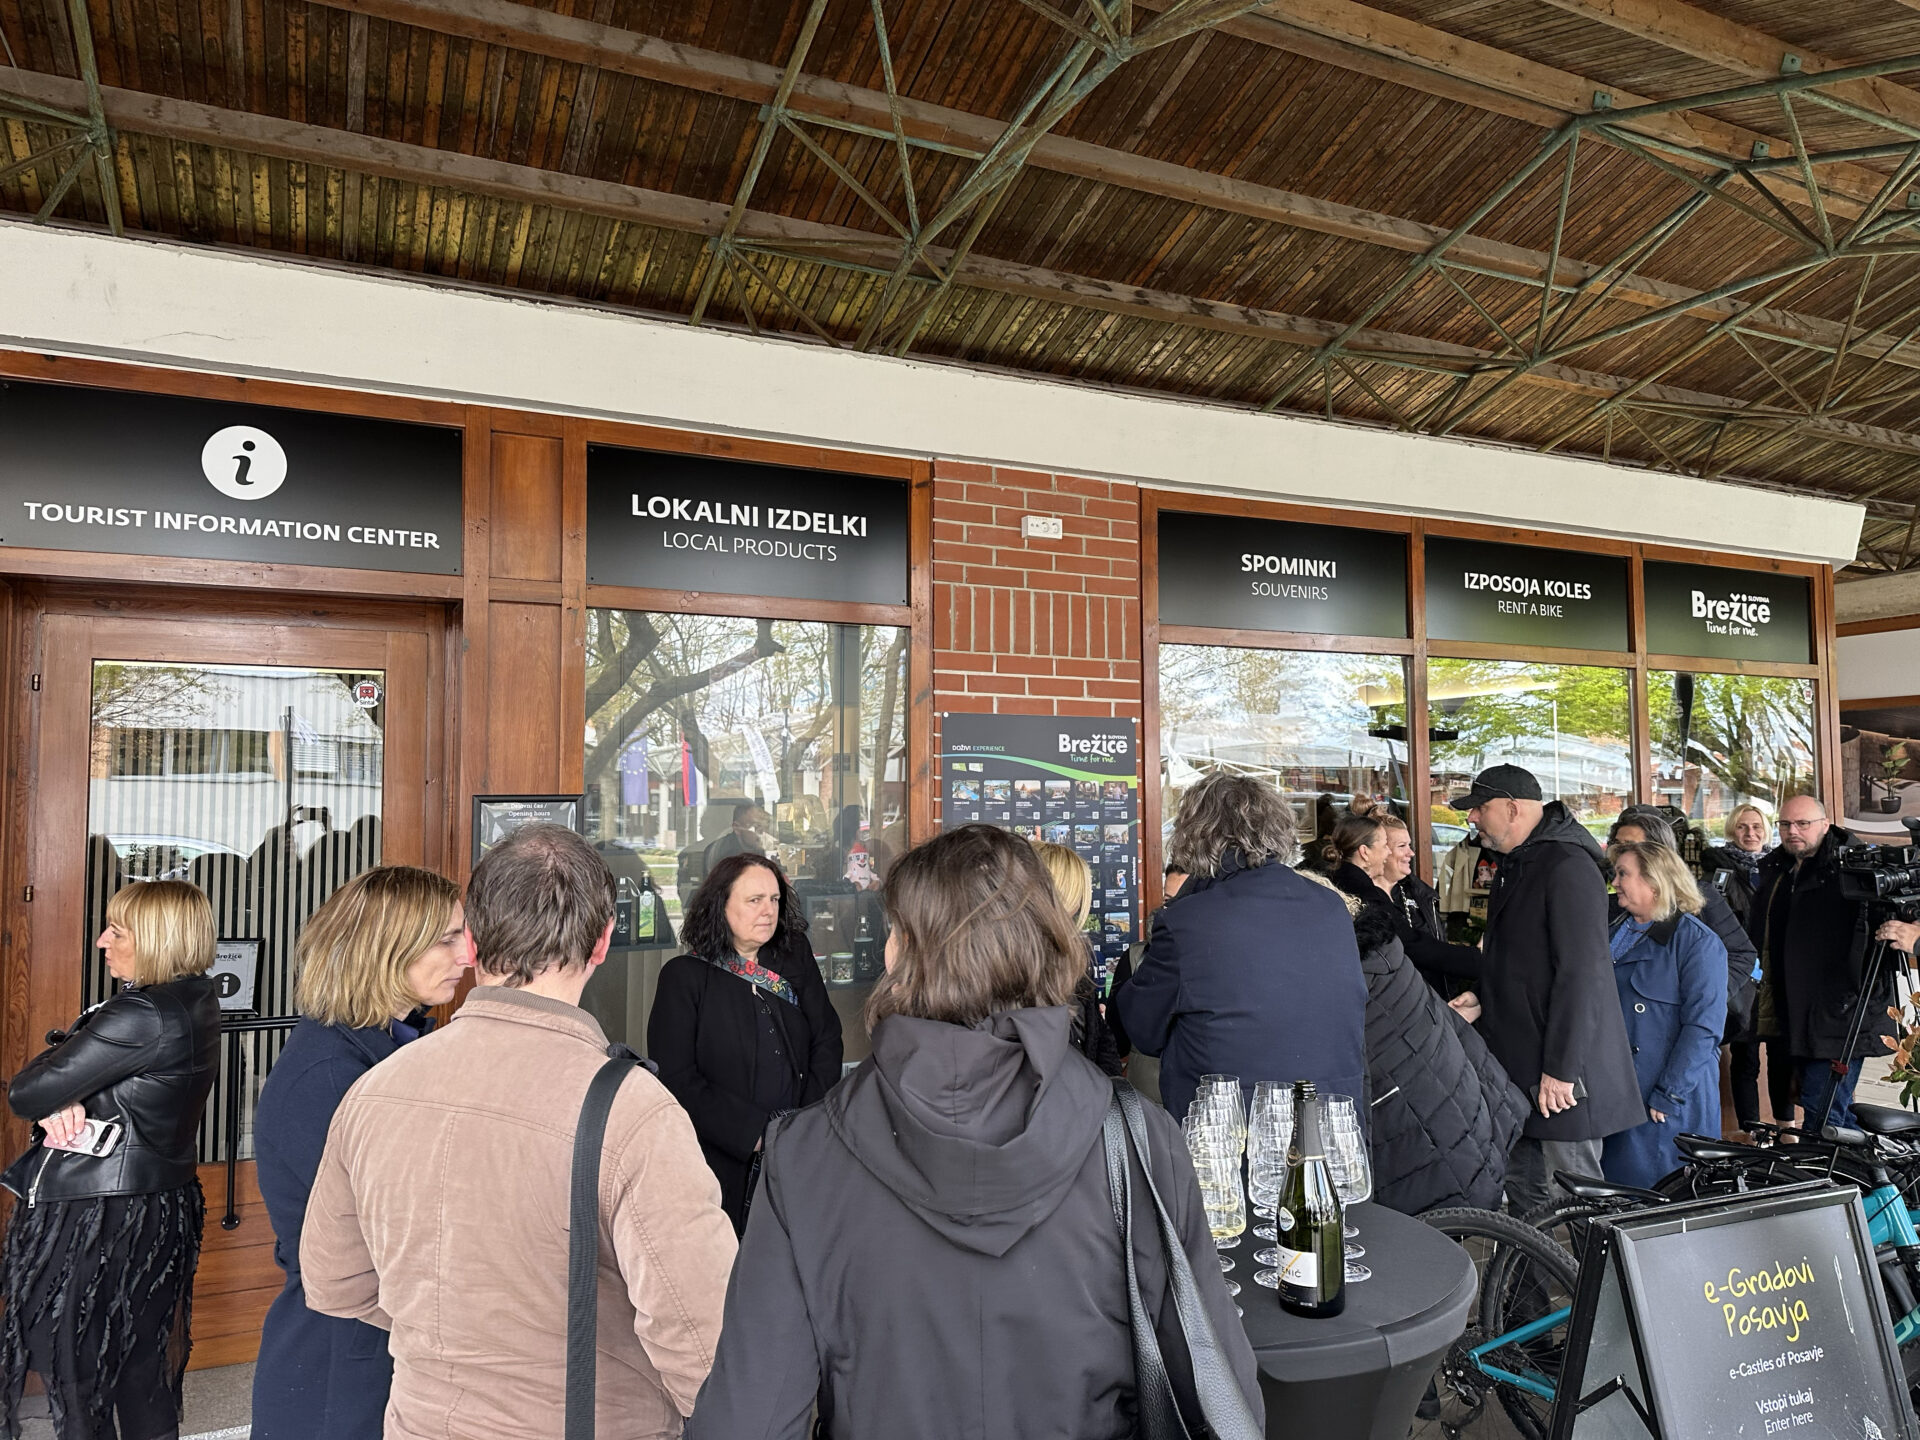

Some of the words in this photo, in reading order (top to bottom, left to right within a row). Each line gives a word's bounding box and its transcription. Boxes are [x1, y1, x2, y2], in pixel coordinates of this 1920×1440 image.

[23, 501, 148, 528] TOURIST
[154, 511, 341, 542] INFORMATION
[347, 526, 441, 549] CENTER
[632, 493, 759, 528] LOKALNI
[767, 507, 867, 537] IZDELKI
[663, 531, 729, 553] LOCAL
[733, 537, 837, 562] PRODUCTS
[1241, 553, 1337, 579] SPOMINKI
[1251, 581, 1329, 601] SOUVENIRS
[1464, 571, 1541, 598] IZPOSOJA
[1544, 580, 1592, 600] KOLES
[1497, 600, 1529, 615] RENT
[1529, 602, 1539, 616] A
[1539, 603, 1564, 618] BIKE
[1691, 590, 1771, 626] Brežice
[1705, 620, 1728, 634] Time
[1728, 622, 1741, 636] for
[1742, 627, 1759, 637] me.
[972, 744, 1006, 752] EXPERIENCE
[1058, 733, 1128, 756] Brežice
[1070, 754, 1088, 763] Time
[1089, 754, 1101, 764] for
[1703, 1255, 1816, 1304] e-Gradovi
[1722, 1296, 1810, 1343] Posavja
[1729, 1357, 1775, 1380] e-Castles
[1776, 1352, 1787, 1368] of
[1787, 1345, 1824, 1366] Posavje
[1755, 1394, 1789, 1415] Vstopi
[1788, 1388, 1814, 1408] tukaj
[1764, 1415, 1791, 1437] Enter
[1790, 1410, 1814, 1427] here
